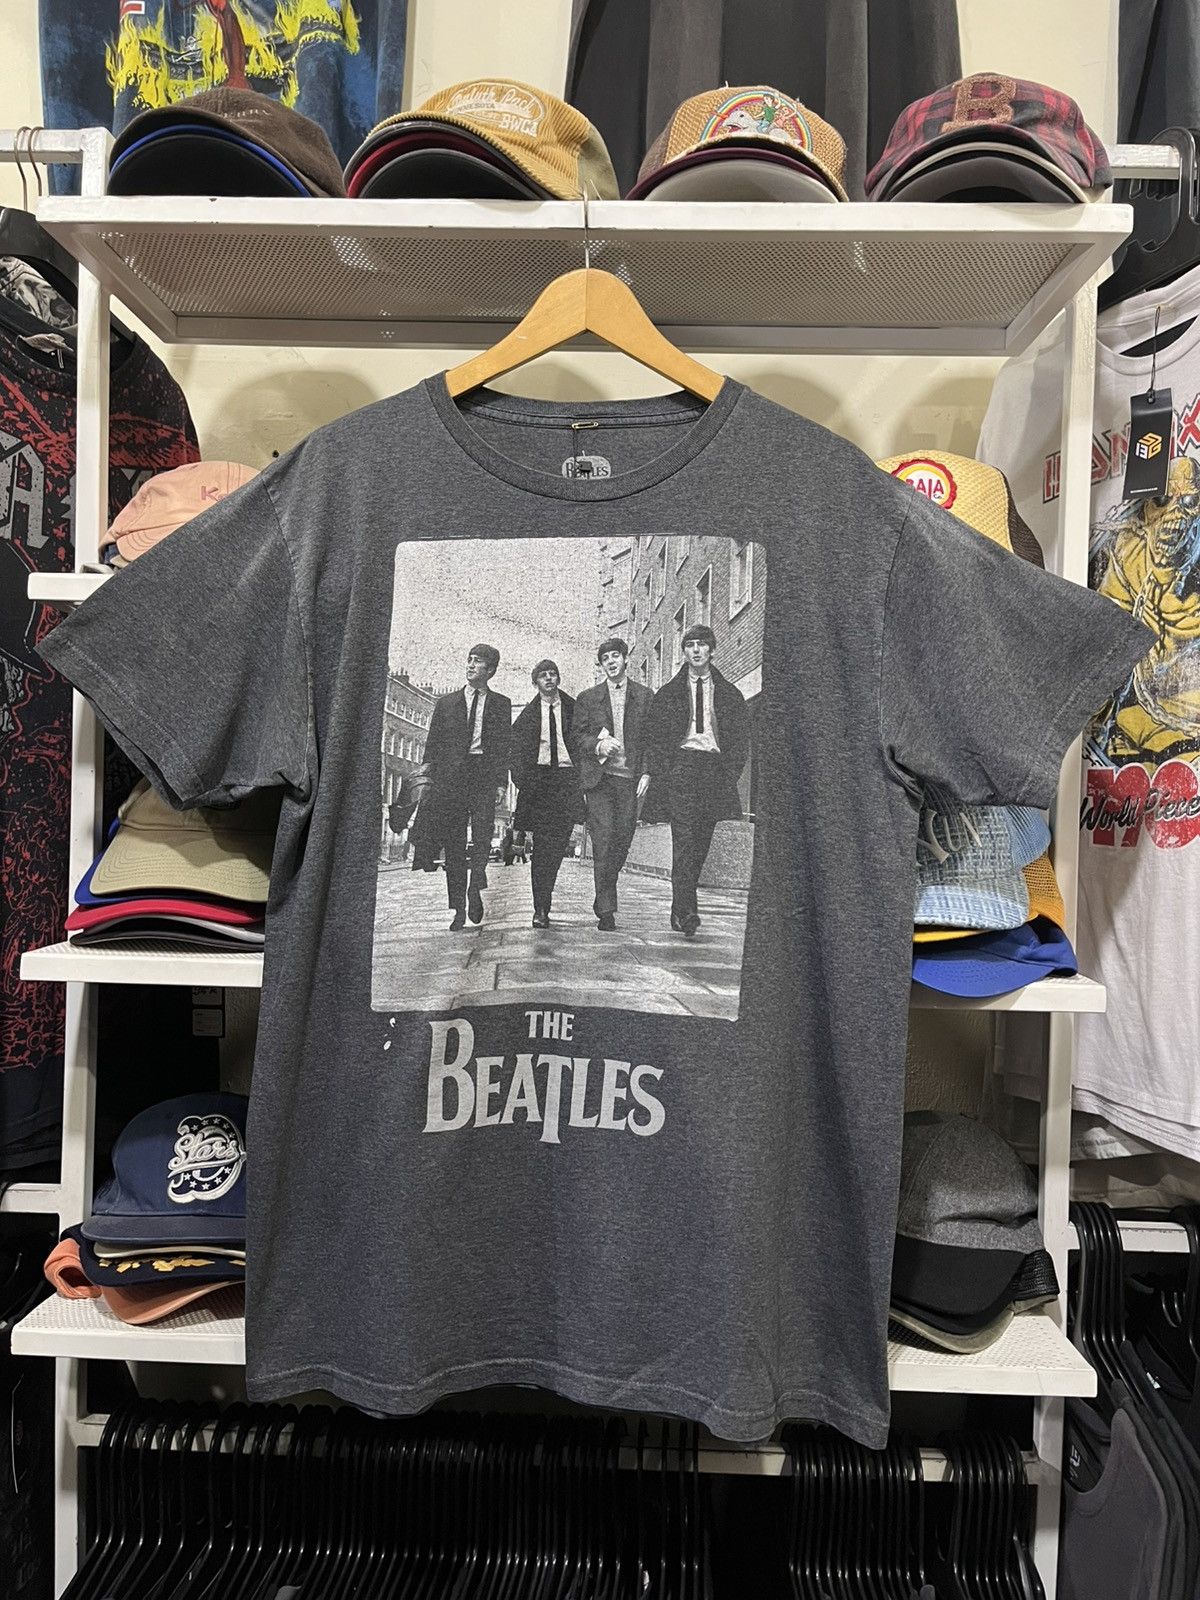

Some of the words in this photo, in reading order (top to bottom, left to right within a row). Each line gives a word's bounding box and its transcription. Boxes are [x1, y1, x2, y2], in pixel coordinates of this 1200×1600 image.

[942, 76, 1016, 134] B
[1080, 795, 1142, 831] World
[525, 1010, 575, 1041] THE
[422, 1018, 666, 1144] BEATLES
[167, 1133, 239, 1178] Stars
